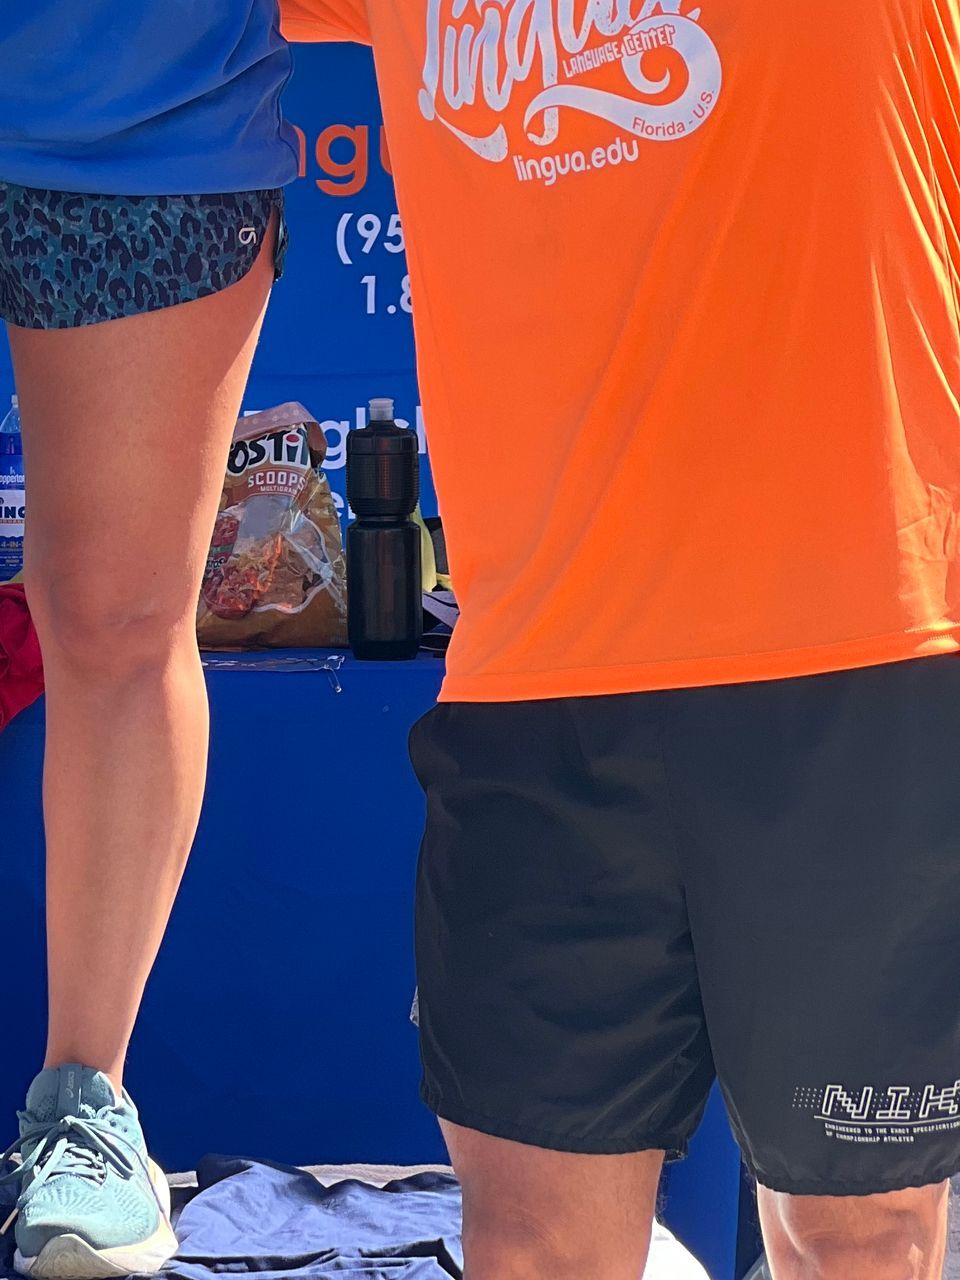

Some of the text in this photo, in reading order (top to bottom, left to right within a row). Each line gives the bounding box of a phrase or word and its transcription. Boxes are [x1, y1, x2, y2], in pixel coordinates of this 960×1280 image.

[563, 24, 676, 78] LANGUAGE CENTER
[633, 116, 685, 137] Florida
[513, 137, 639, 185] lingua.edu
